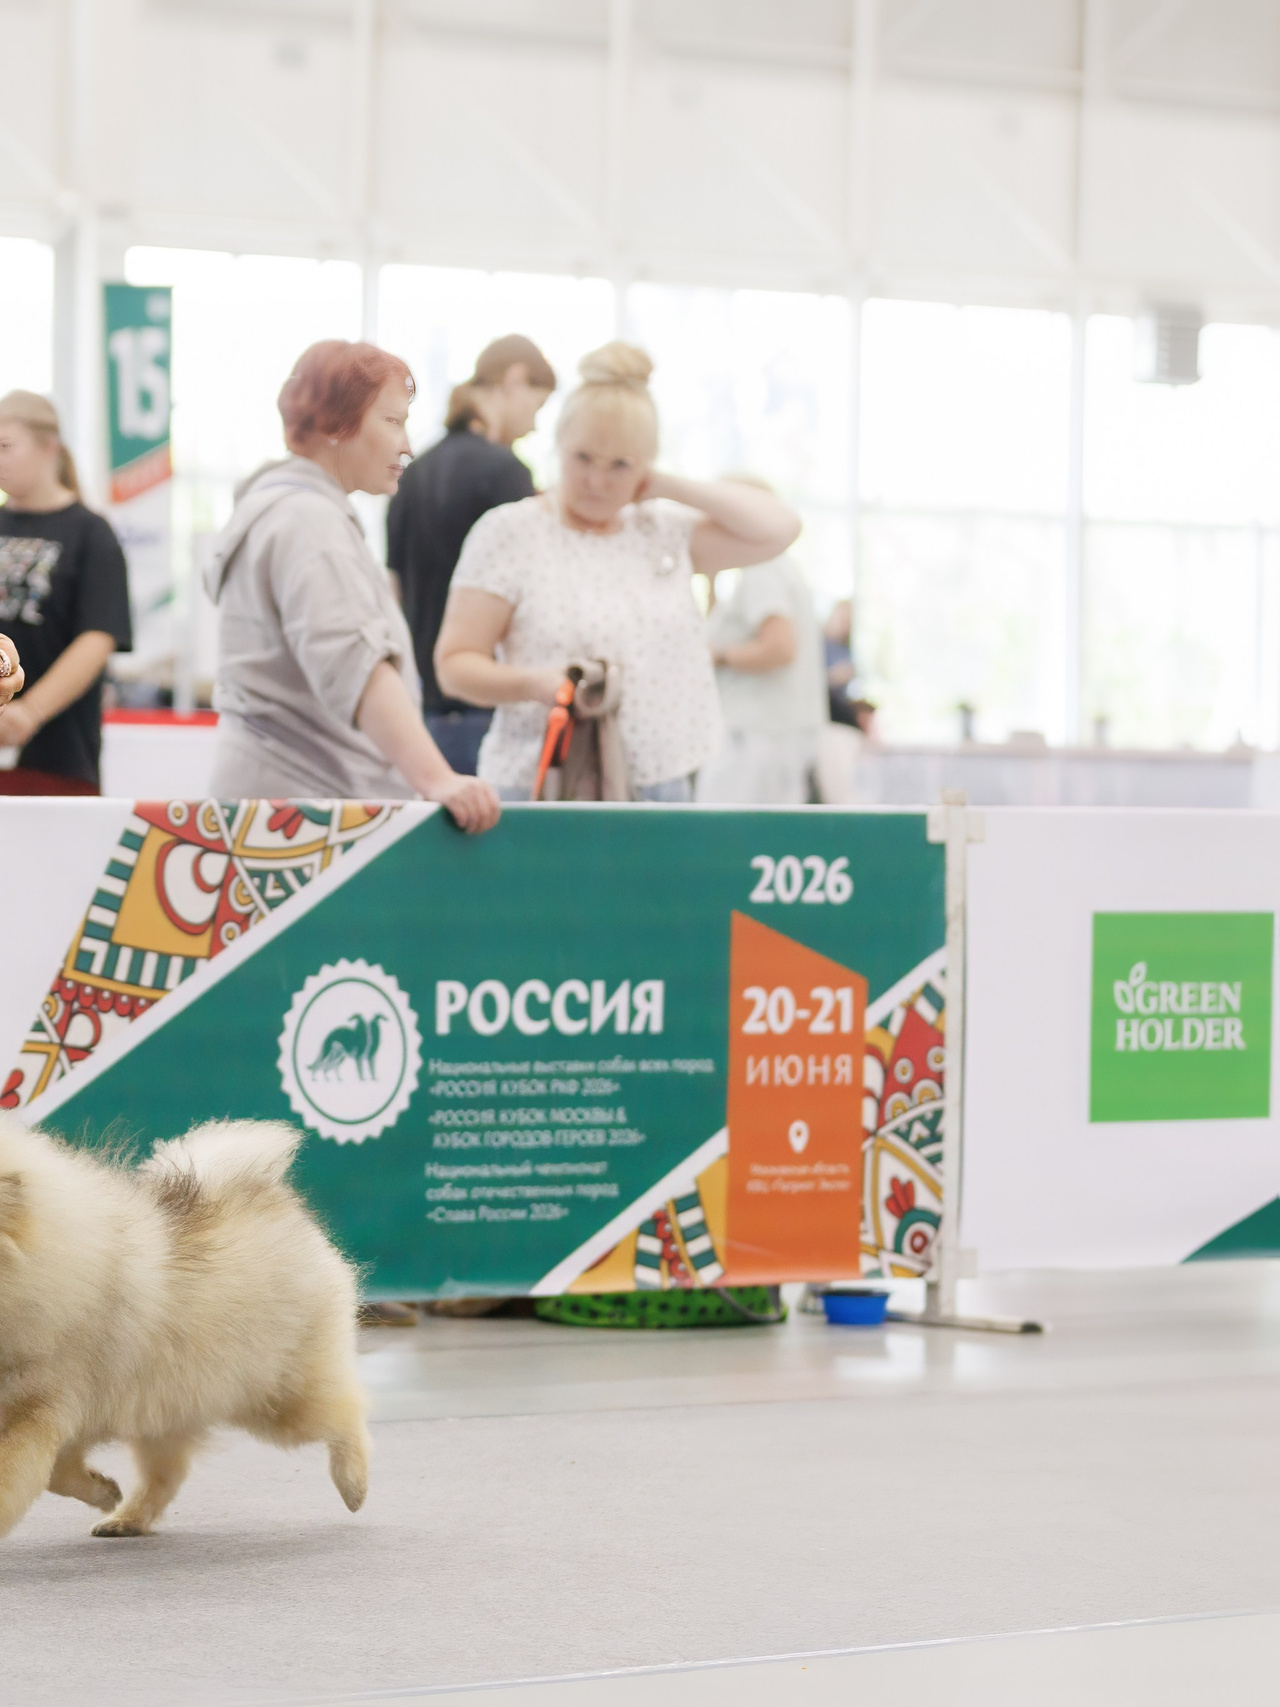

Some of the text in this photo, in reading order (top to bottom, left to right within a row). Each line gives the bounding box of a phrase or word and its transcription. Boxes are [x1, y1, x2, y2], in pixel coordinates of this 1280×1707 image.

[750, 855, 853, 904] 2026
[436, 979, 664, 1035] РОССИЯ
[742, 987, 853, 1034] 20-21
[1134, 980, 1242, 1015] GREEN
[1116, 1018, 1245, 1051] HOLDER
[747, 1054, 852, 1086] ИЮНЯ
